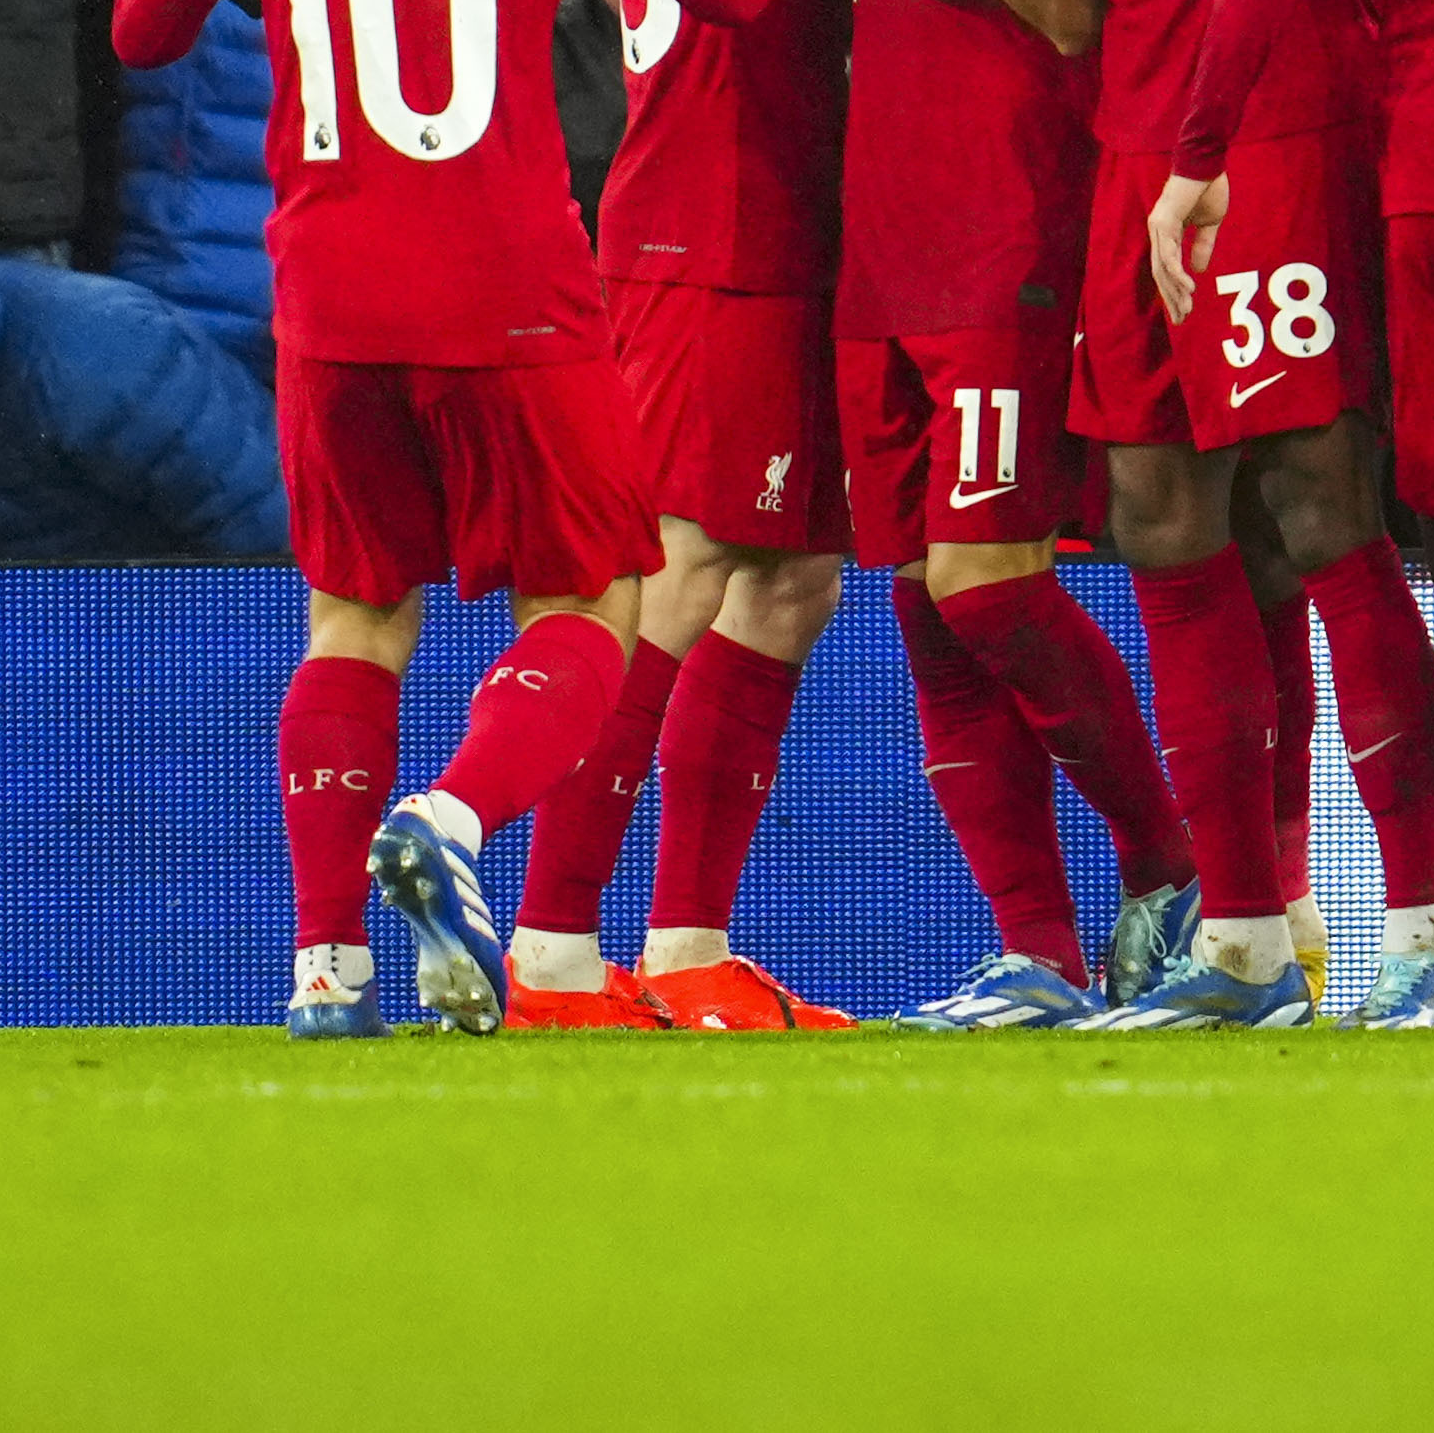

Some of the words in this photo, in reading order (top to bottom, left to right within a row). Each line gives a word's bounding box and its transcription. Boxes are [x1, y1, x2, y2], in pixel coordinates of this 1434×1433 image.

[1215, 261, 1336, 368] 38
[953, 388, 1020, 483] 11
[756, 495, 783, 513] LFC
[288, 768, 369, 795] LFC
